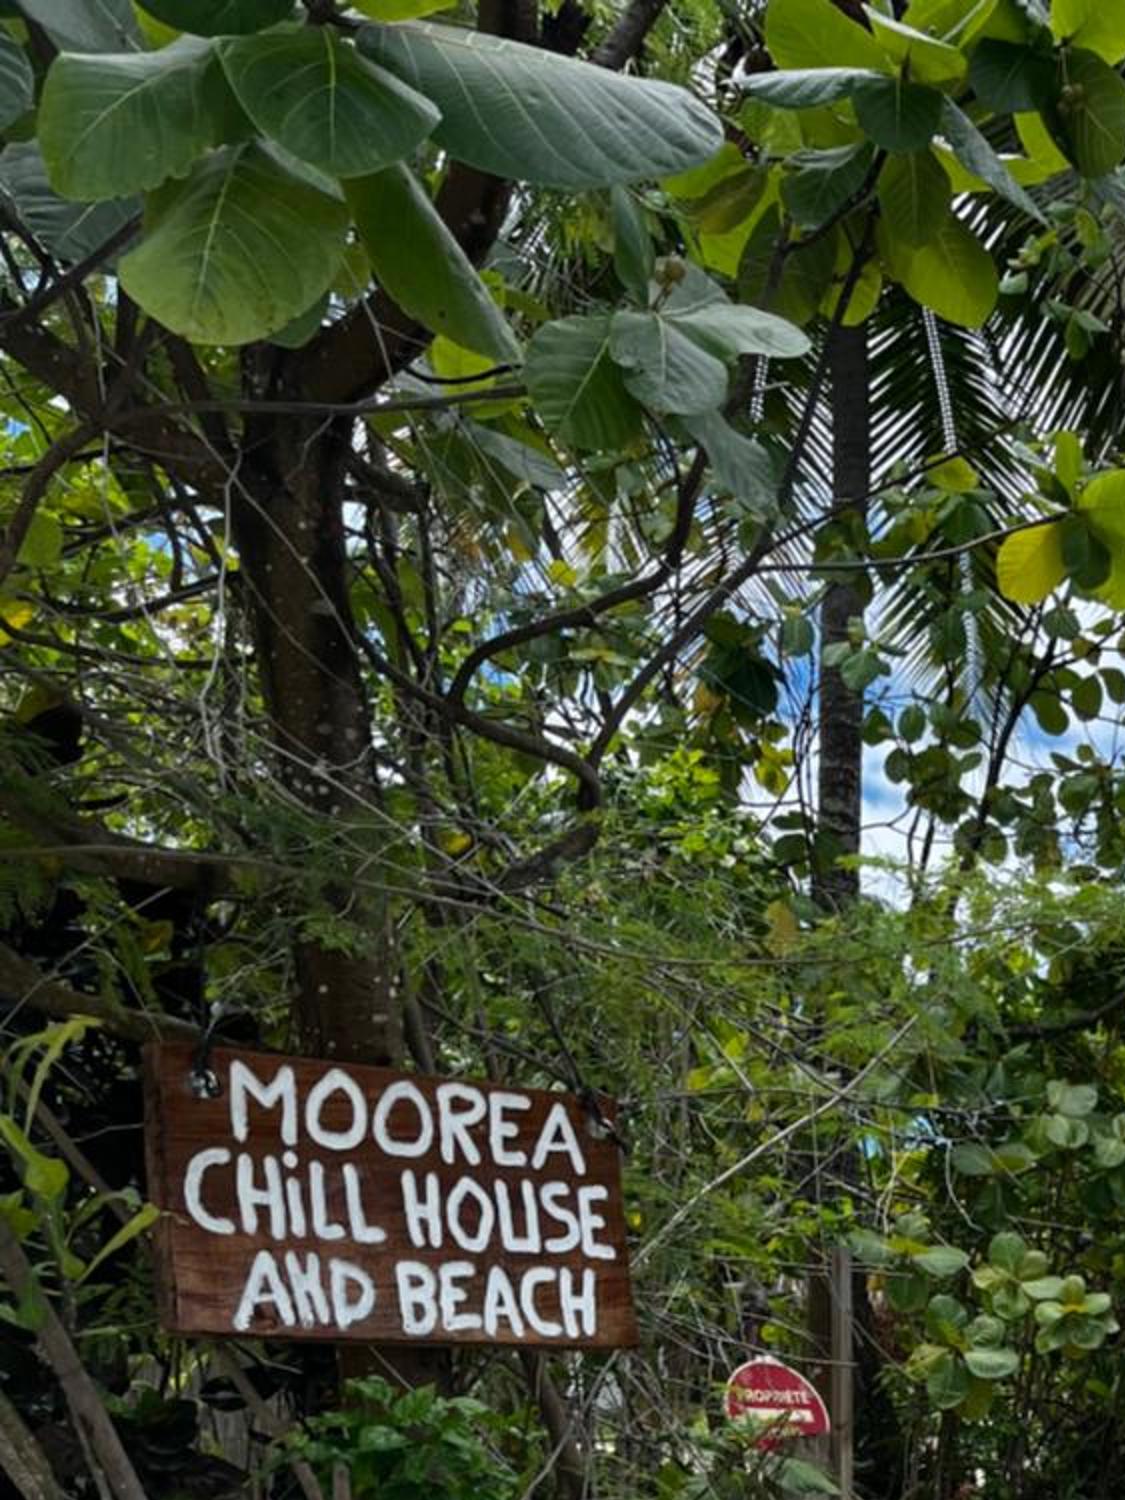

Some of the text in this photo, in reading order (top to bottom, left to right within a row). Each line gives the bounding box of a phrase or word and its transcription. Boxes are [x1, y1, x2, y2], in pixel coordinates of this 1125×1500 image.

[230, 1058, 587, 1175] MOOREA
[402, 1168, 616, 1260] HOUSE
[233, 1250, 597, 1339] AND BEACH
